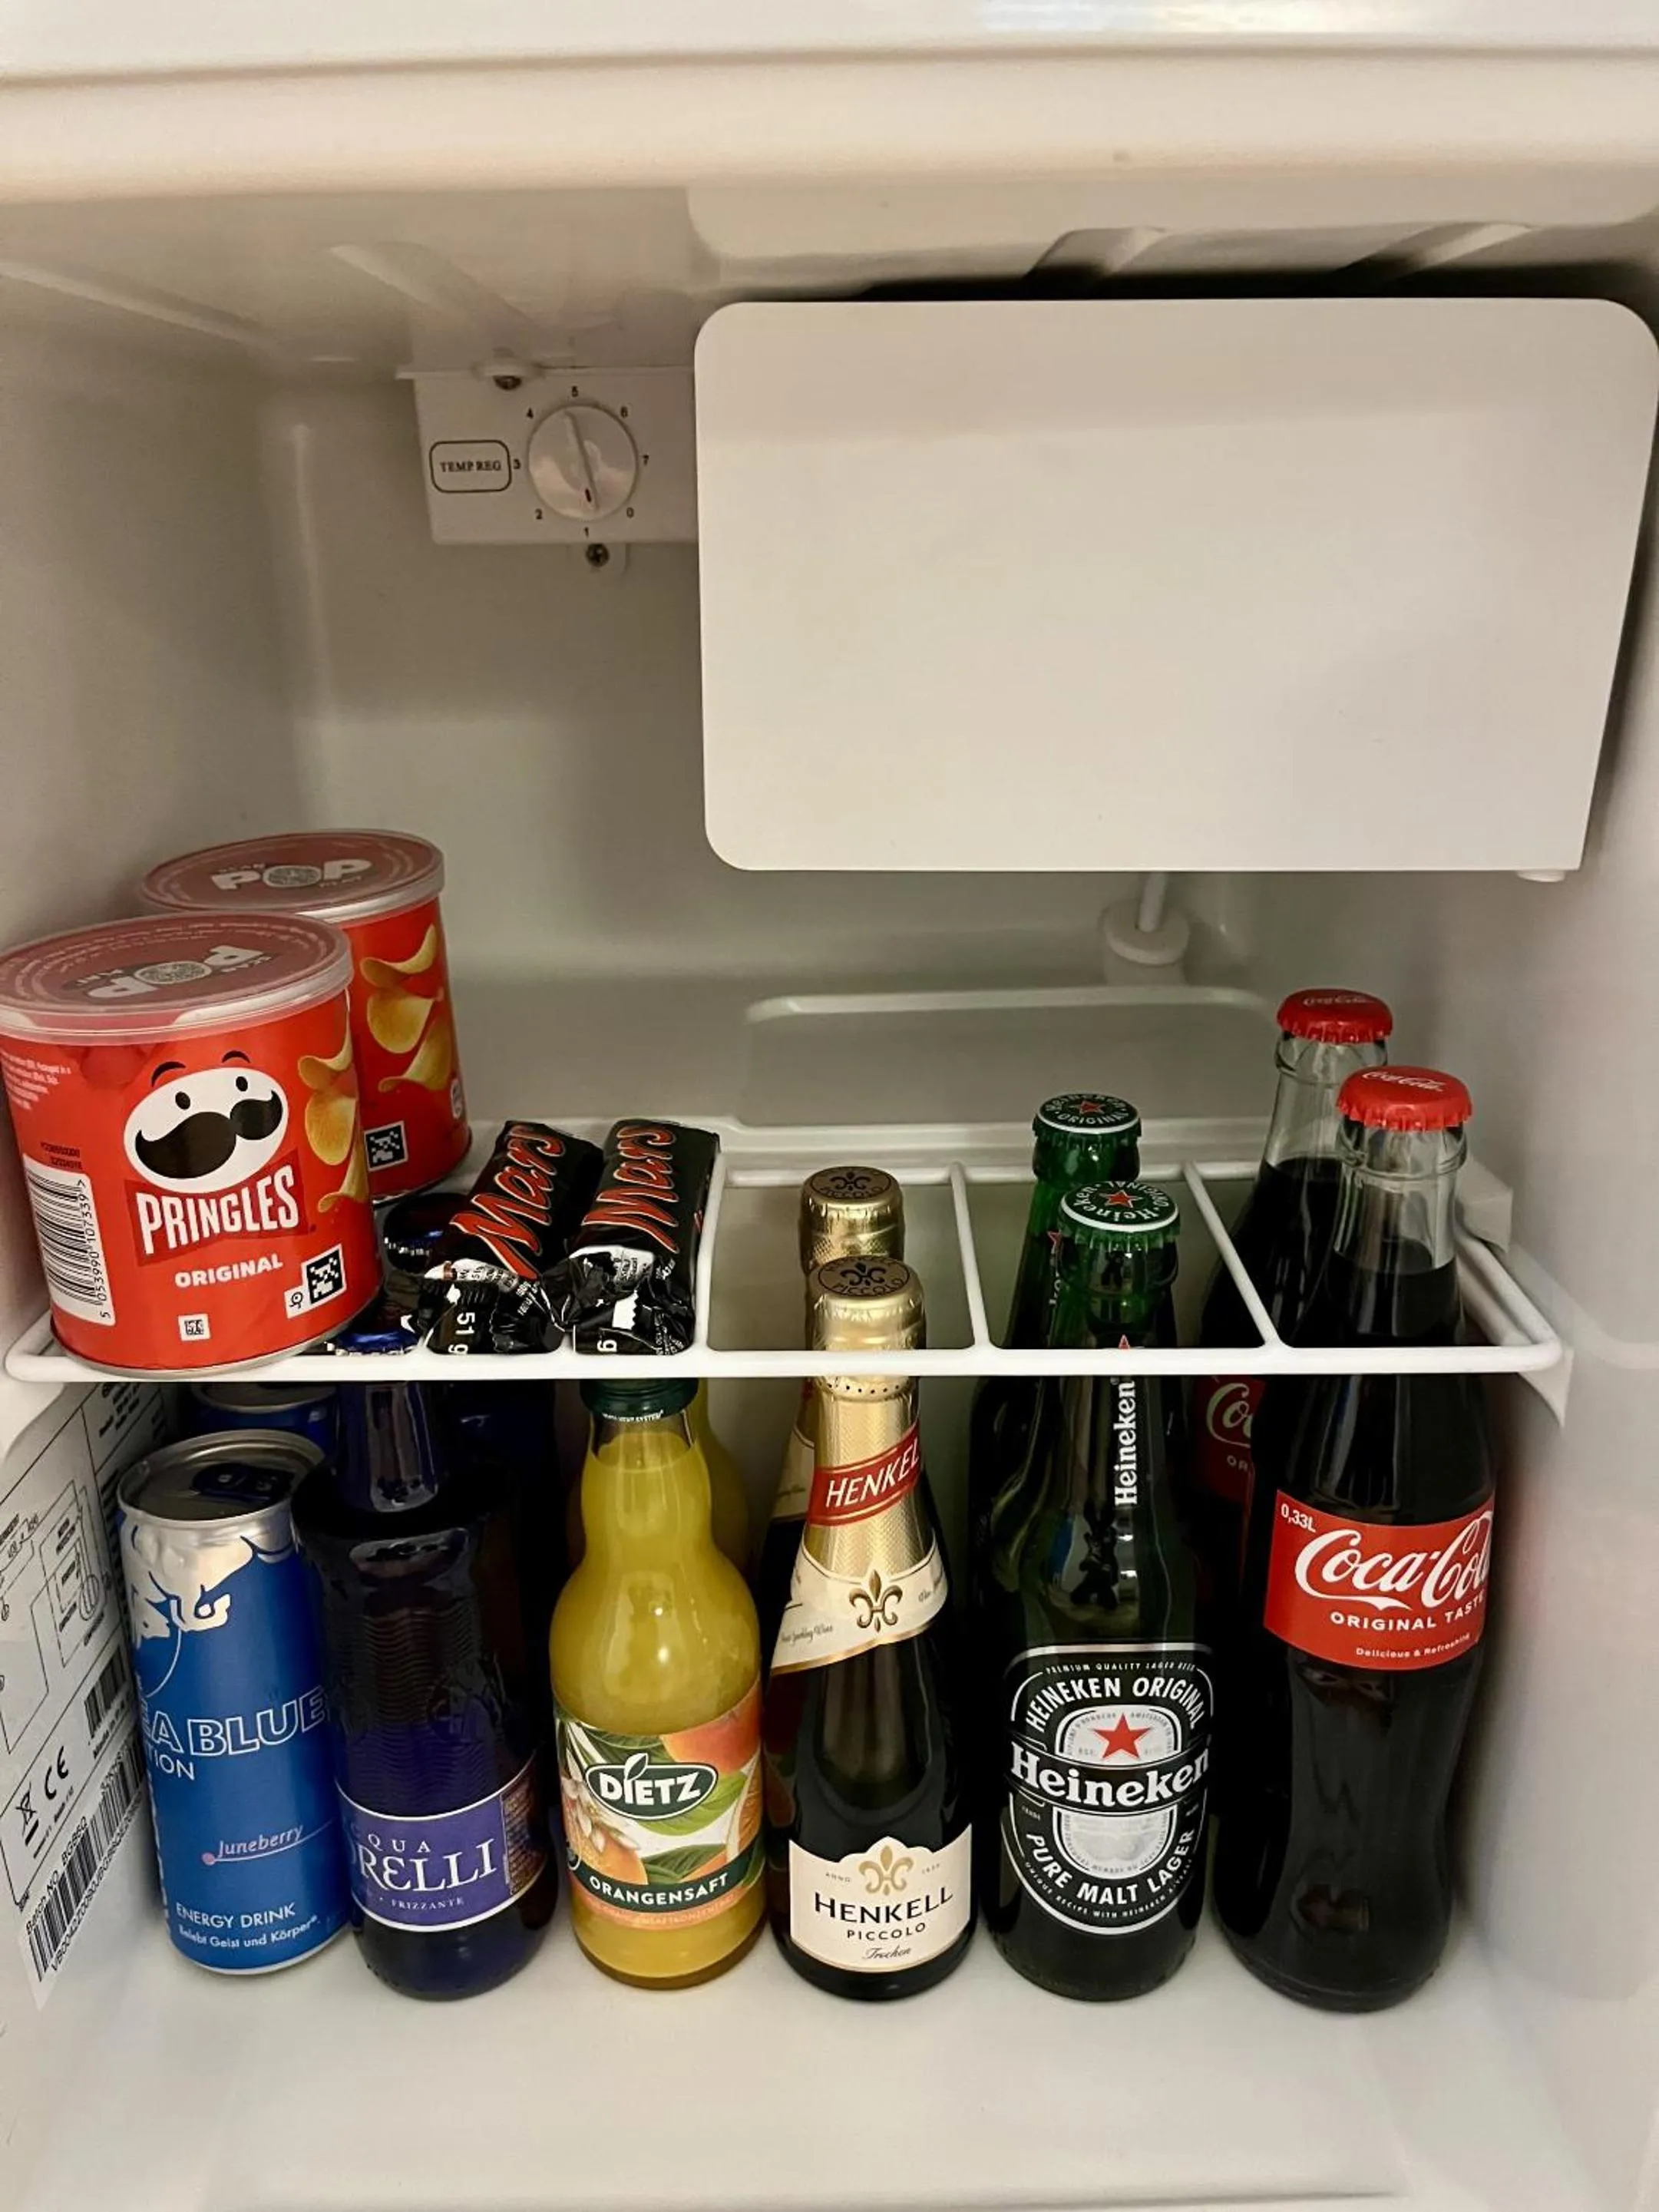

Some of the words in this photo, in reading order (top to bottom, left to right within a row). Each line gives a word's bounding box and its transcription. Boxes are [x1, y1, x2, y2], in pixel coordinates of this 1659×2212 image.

[571, 385, 579, 398] 5
[526, 408, 534, 419] 4
[620, 406, 629, 418] 6
[439, 461, 475, 473] TEMP
[476, 460, 502, 471] REG
[513, 458, 521, 470] 3
[642, 454, 650, 467] 7
[535, 508, 544, 521] 2
[1056, 1112, 1129, 1125] ORIGINAL
[450, 1124, 566, 1281] Mars
[581, 1124, 679, 1255] Mars
[78, 1192, 95, 1242] 107339
[135, 1164, 300, 1255] PRINGLES
[1074, 1186, 1159, 1222] Heineken
[90, 1250, 107, 1301] 053990
[174, 1253, 284, 1288] ORIGINAL
[100, 1310, 111, 1321] 5
[454, 1311, 476, 1335] 51
[1113, 1380, 1138, 1506] Heineken
[1280, 1503, 1317, 1533] 0,33L
[1330, 1611, 1437, 1632] ORIGINAL
[1355, 1646, 1410, 1659] Delicious
[1413, 1648, 1421, 1658] &
[1096, 1662, 1142, 1671] QUALITY
[1025, 1677, 1122, 1734] HEINEKEN
[1132, 1676, 1206, 1731] ORIGINAL
[187, 1685, 328, 1757] BLUE
[1010, 1741, 1210, 1807] Heineken
[598, 1771, 702, 1806] DIETZ
[218, 1824, 305, 1858] Juneberry
[1026, 1833, 1073, 1889] PURE
[1076, 1882, 1139, 1906] MALT
[1147, 1829, 1195, 1893] LAGER
[588, 1872, 729, 1906] ORANGENSAFT
[176, 1901, 234, 1929] ENERGY
[240, 1901, 296, 1929] DRINK
[391, 1896, 464, 1910] FRIZZANTE
[814, 1886, 954, 1924] HENKELL
[1093, 1909, 1118, 1919] WITH
[210, 1936, 240, 1949] Geist
[243, 1933, 267, 1948] und
[846, 1922, 927, 1943] PICCOLO
[861, 1944, 912, 1960] Trocken
